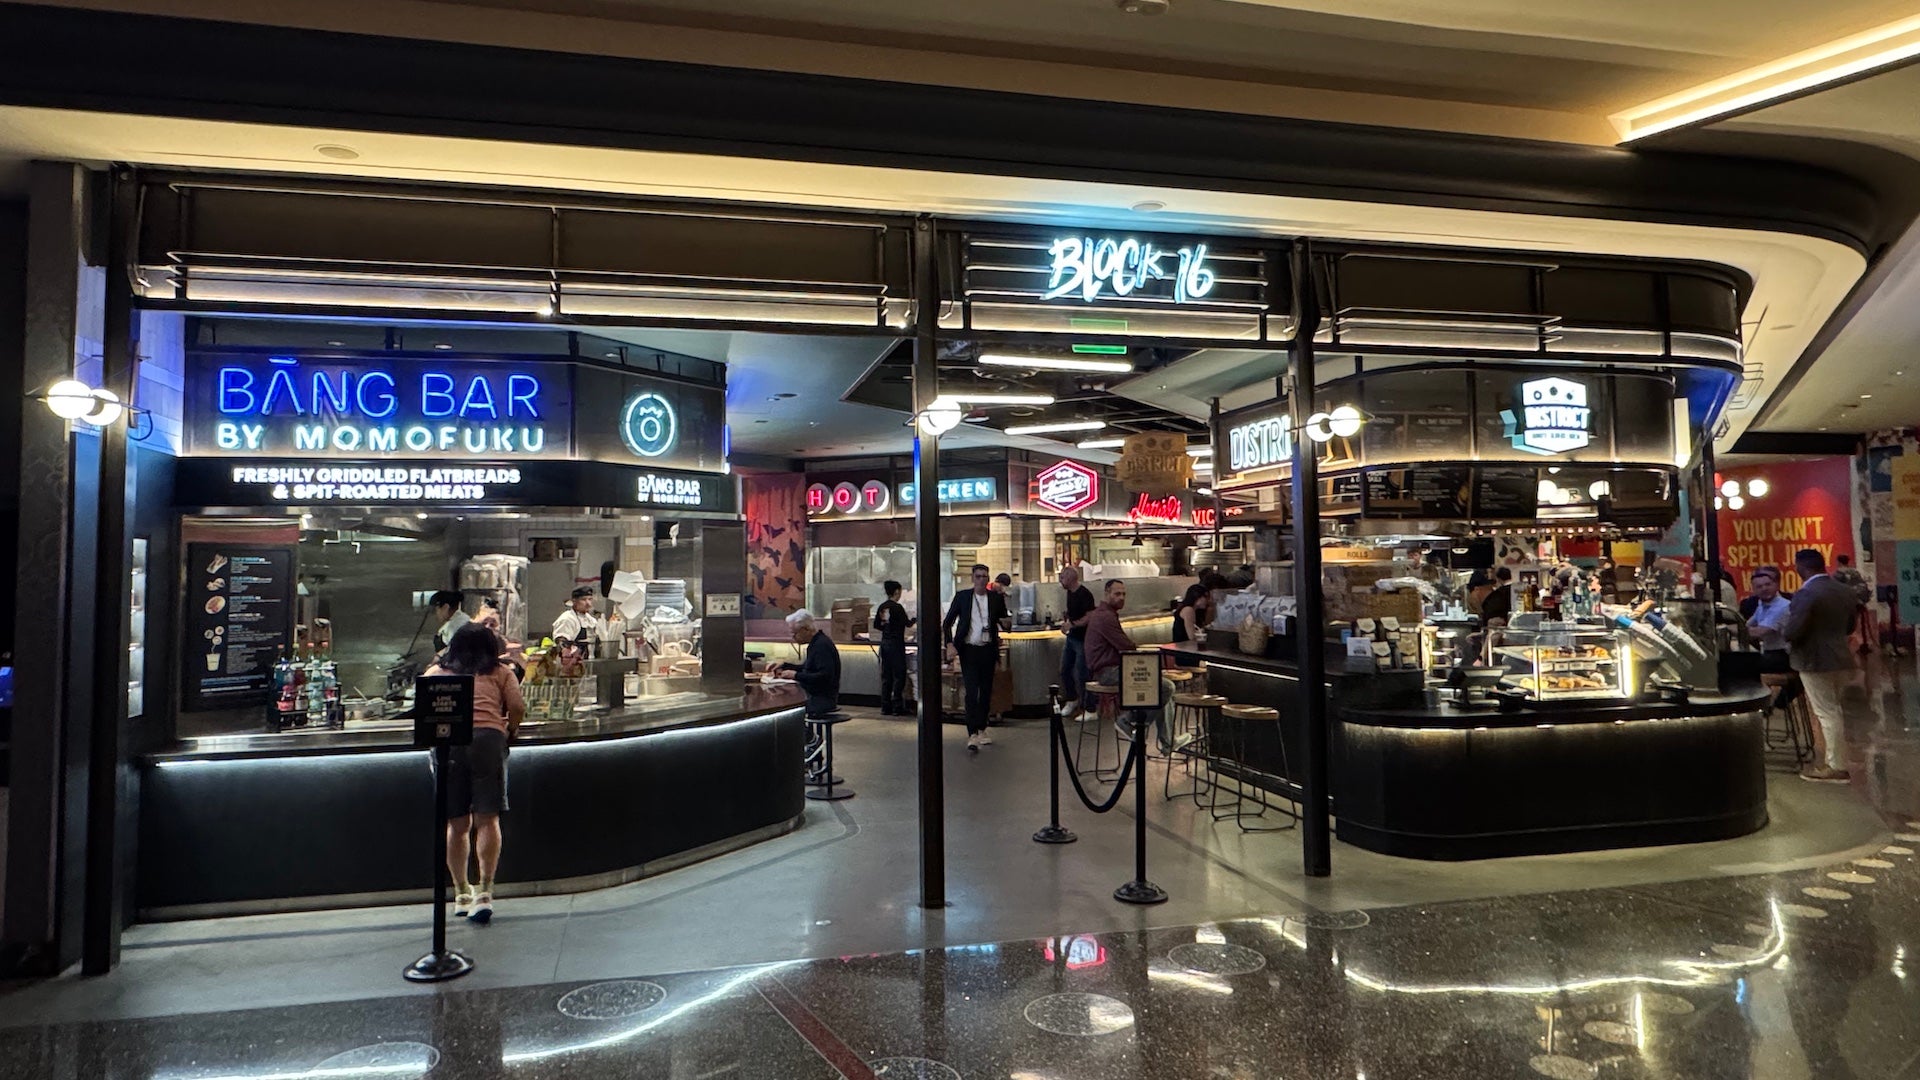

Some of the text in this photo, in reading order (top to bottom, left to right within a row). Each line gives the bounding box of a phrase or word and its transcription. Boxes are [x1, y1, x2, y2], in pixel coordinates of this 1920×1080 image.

[1174, 243, 1214, 304] 16
[421, 372, 541, 419] BAR
[1524, 406, 1590, 429] DISTRICT
[217, 423, 544, 453] BY MOMOFUKU
[233, 467, 521, 484] FRESHLY GRIDDLED FLATBREADS
[1126, 455, 1182, 473] DISTRICT
[272, 484, 485, 500] & SPIT-ROASTED MEATS
[638, 493, 650, 502] BY
[675, 480, 701, 496] BAR
[808, 482, 989, 507] HOT CCKEN
[1732, 516, 1824, 541] YOU CAN'T
[1347, 551, 1369, 559] ROLLS
[1728, 544, 1778, 567] SPELL
